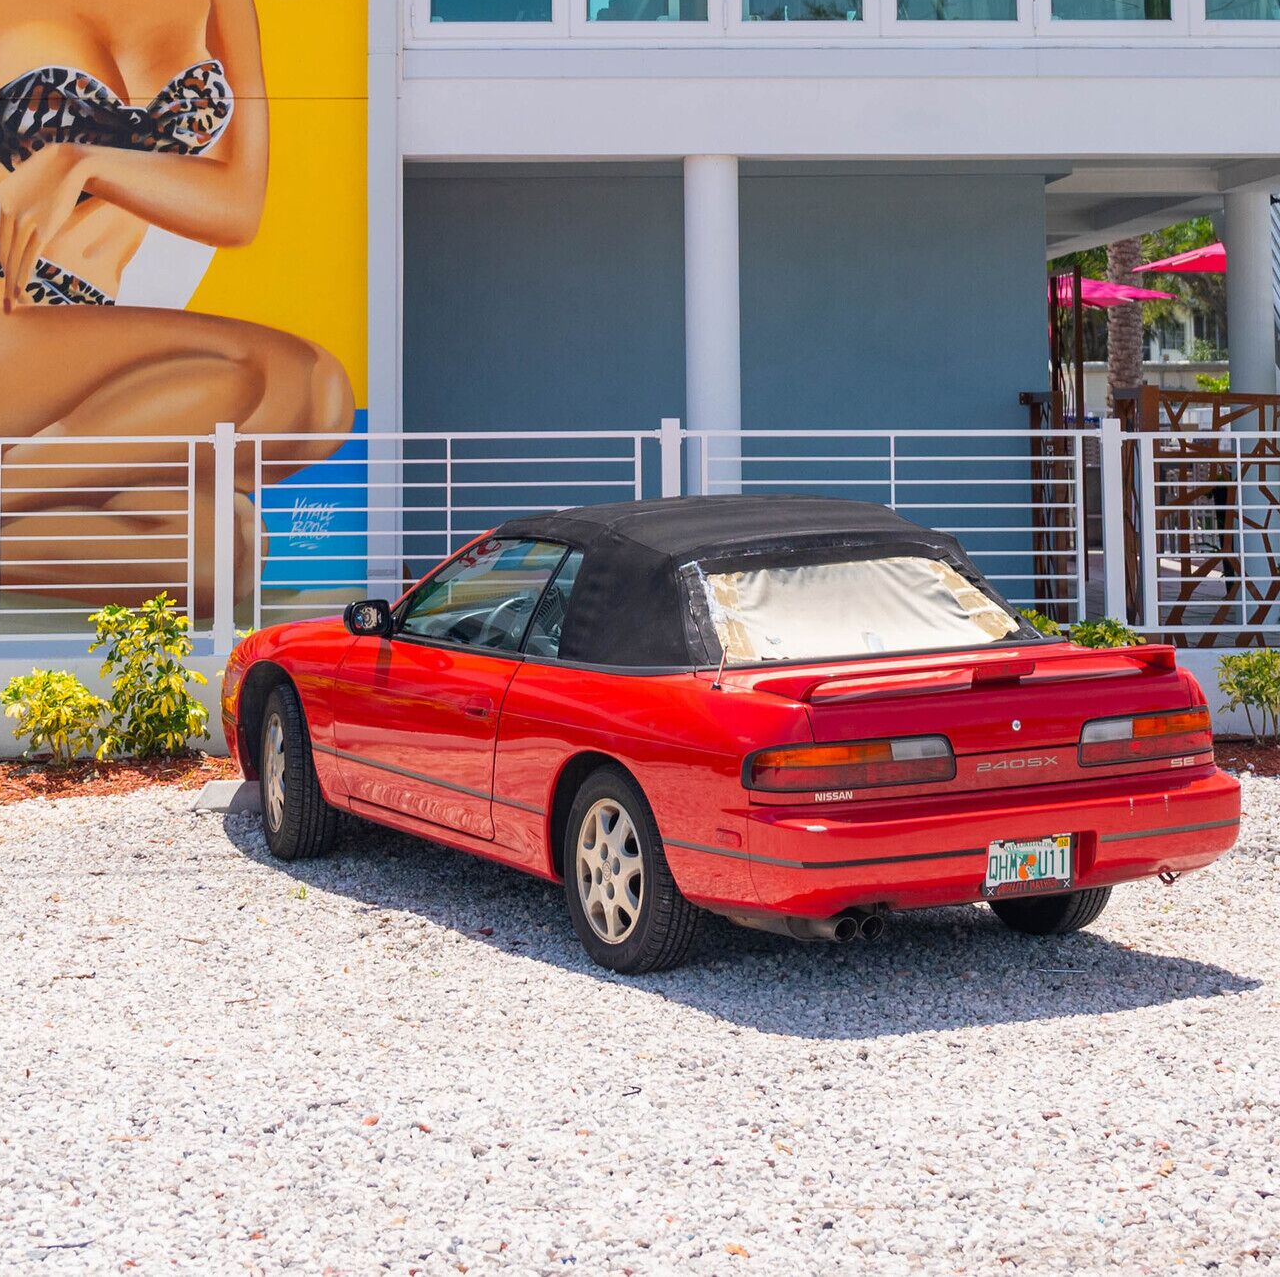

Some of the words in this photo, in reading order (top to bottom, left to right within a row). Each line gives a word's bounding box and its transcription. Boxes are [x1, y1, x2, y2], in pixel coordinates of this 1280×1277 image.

[976, 755, 1059, 773] 240SX
[1170, 756, 1195, 768] SE
[814, 790, 853, 802] NISSAN
[1038, 848, 1065, 877] U11
